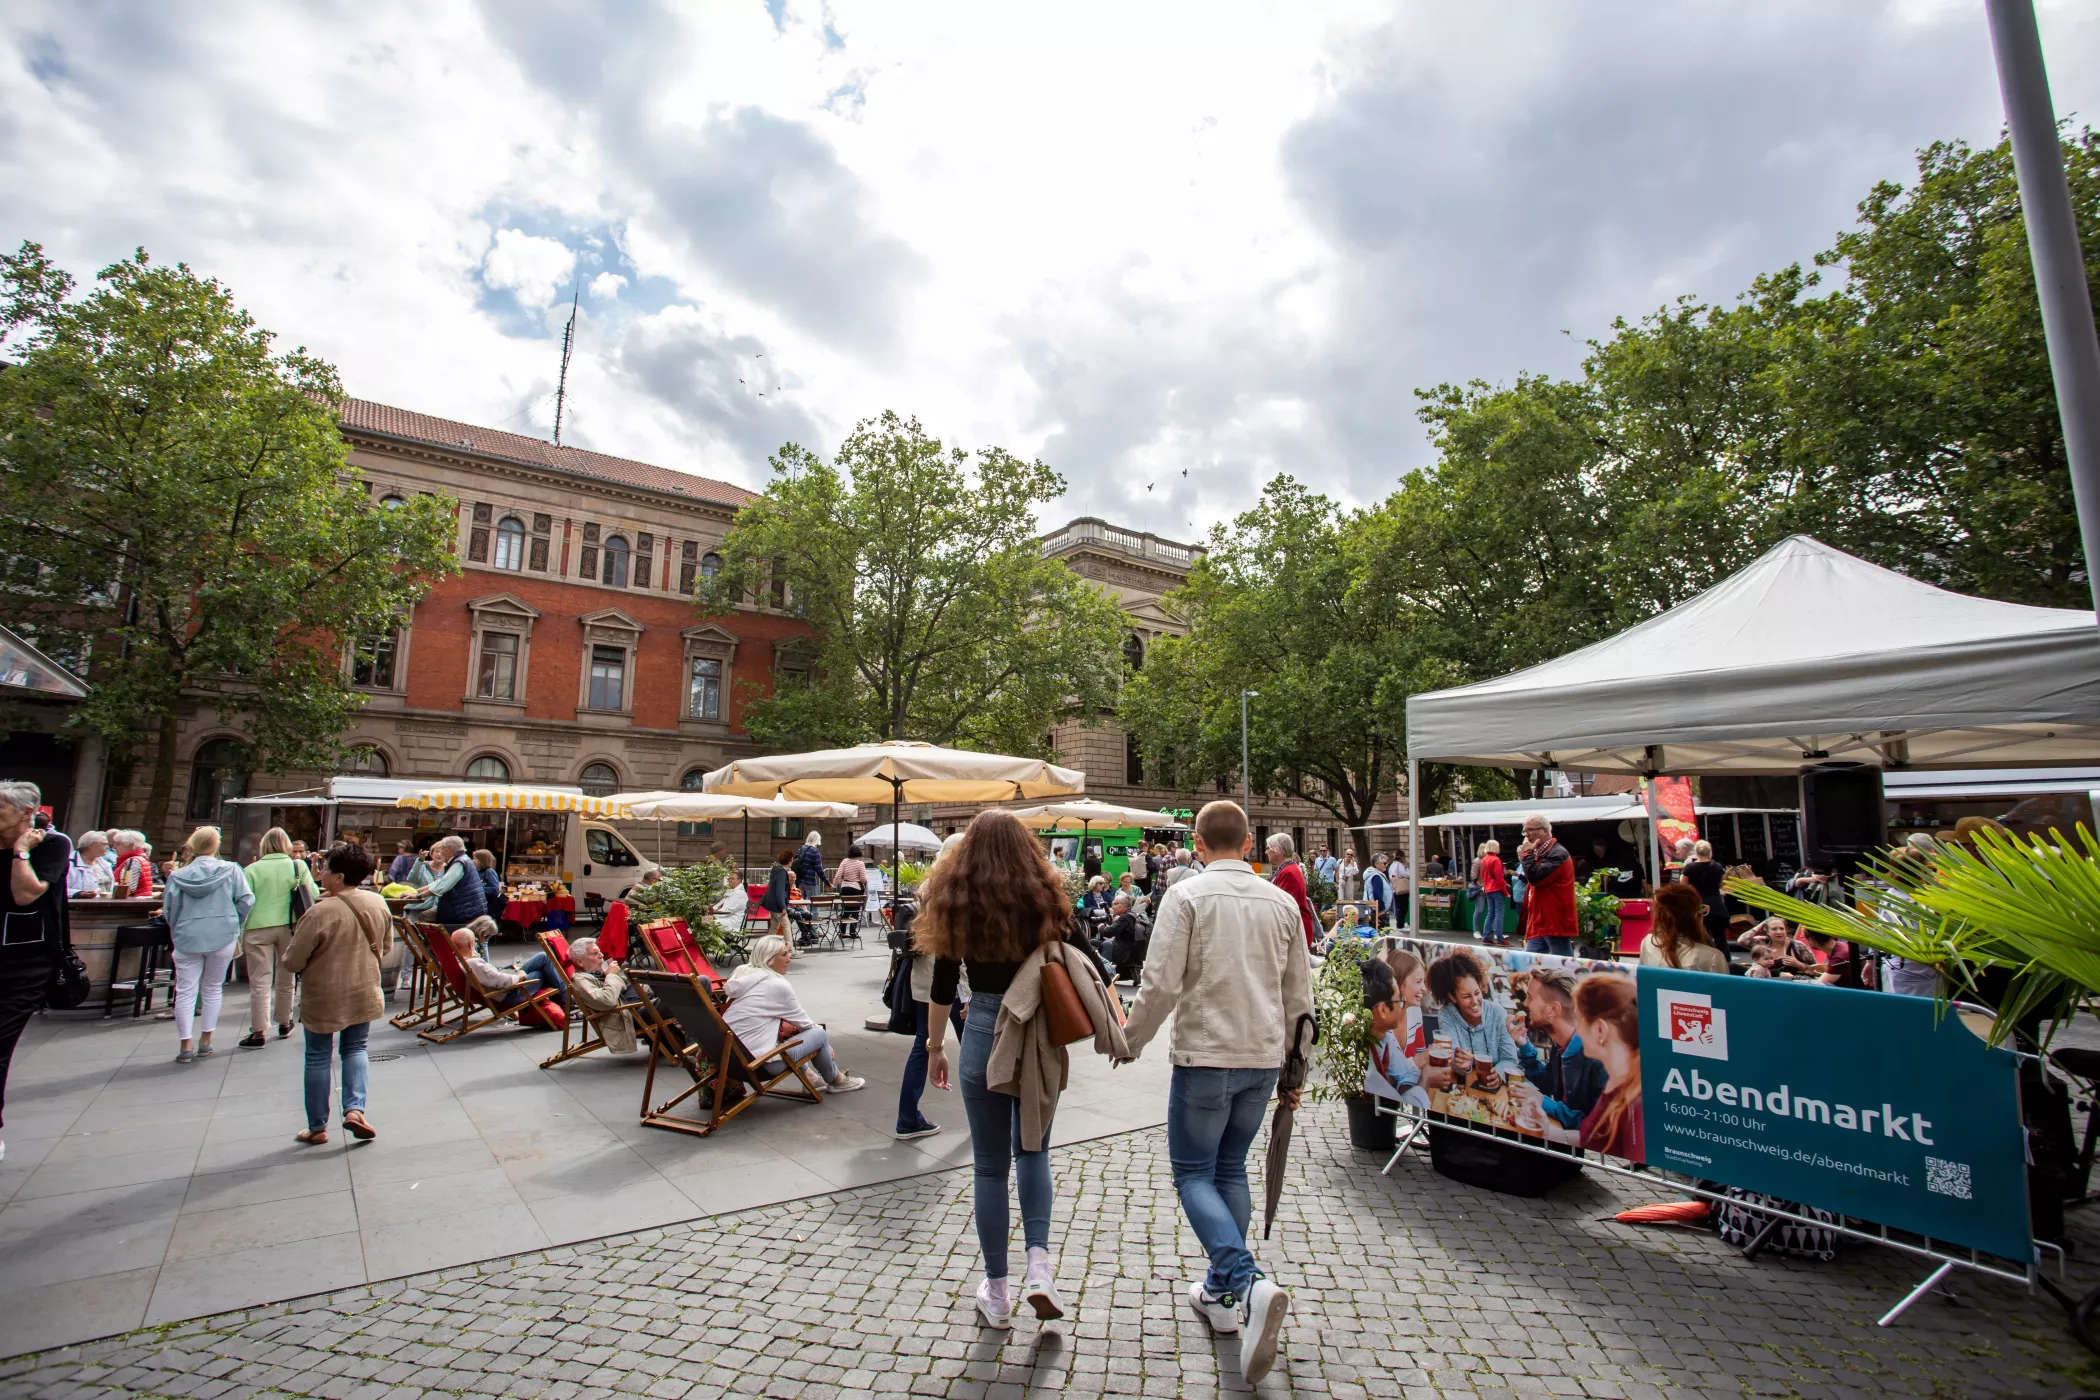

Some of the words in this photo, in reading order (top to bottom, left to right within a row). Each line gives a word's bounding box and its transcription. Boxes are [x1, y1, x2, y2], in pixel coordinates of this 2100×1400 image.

[1673, 1005, 1709, 1016] Braunschweig
[1673, 1010, 1704, 1019] Löwenstadt
[1662, 1067, 1934, 1146] Abendmarkt
[1742, 1117, 1767, 1131] Uhr
[1663, 1123, 1910, 1186] www.braunschweig.de/abendmarkt
[1664, 1146, 1712, 1164] Braunschweig
[1664, 1153, 1703, 1167] Stadtmarketing
